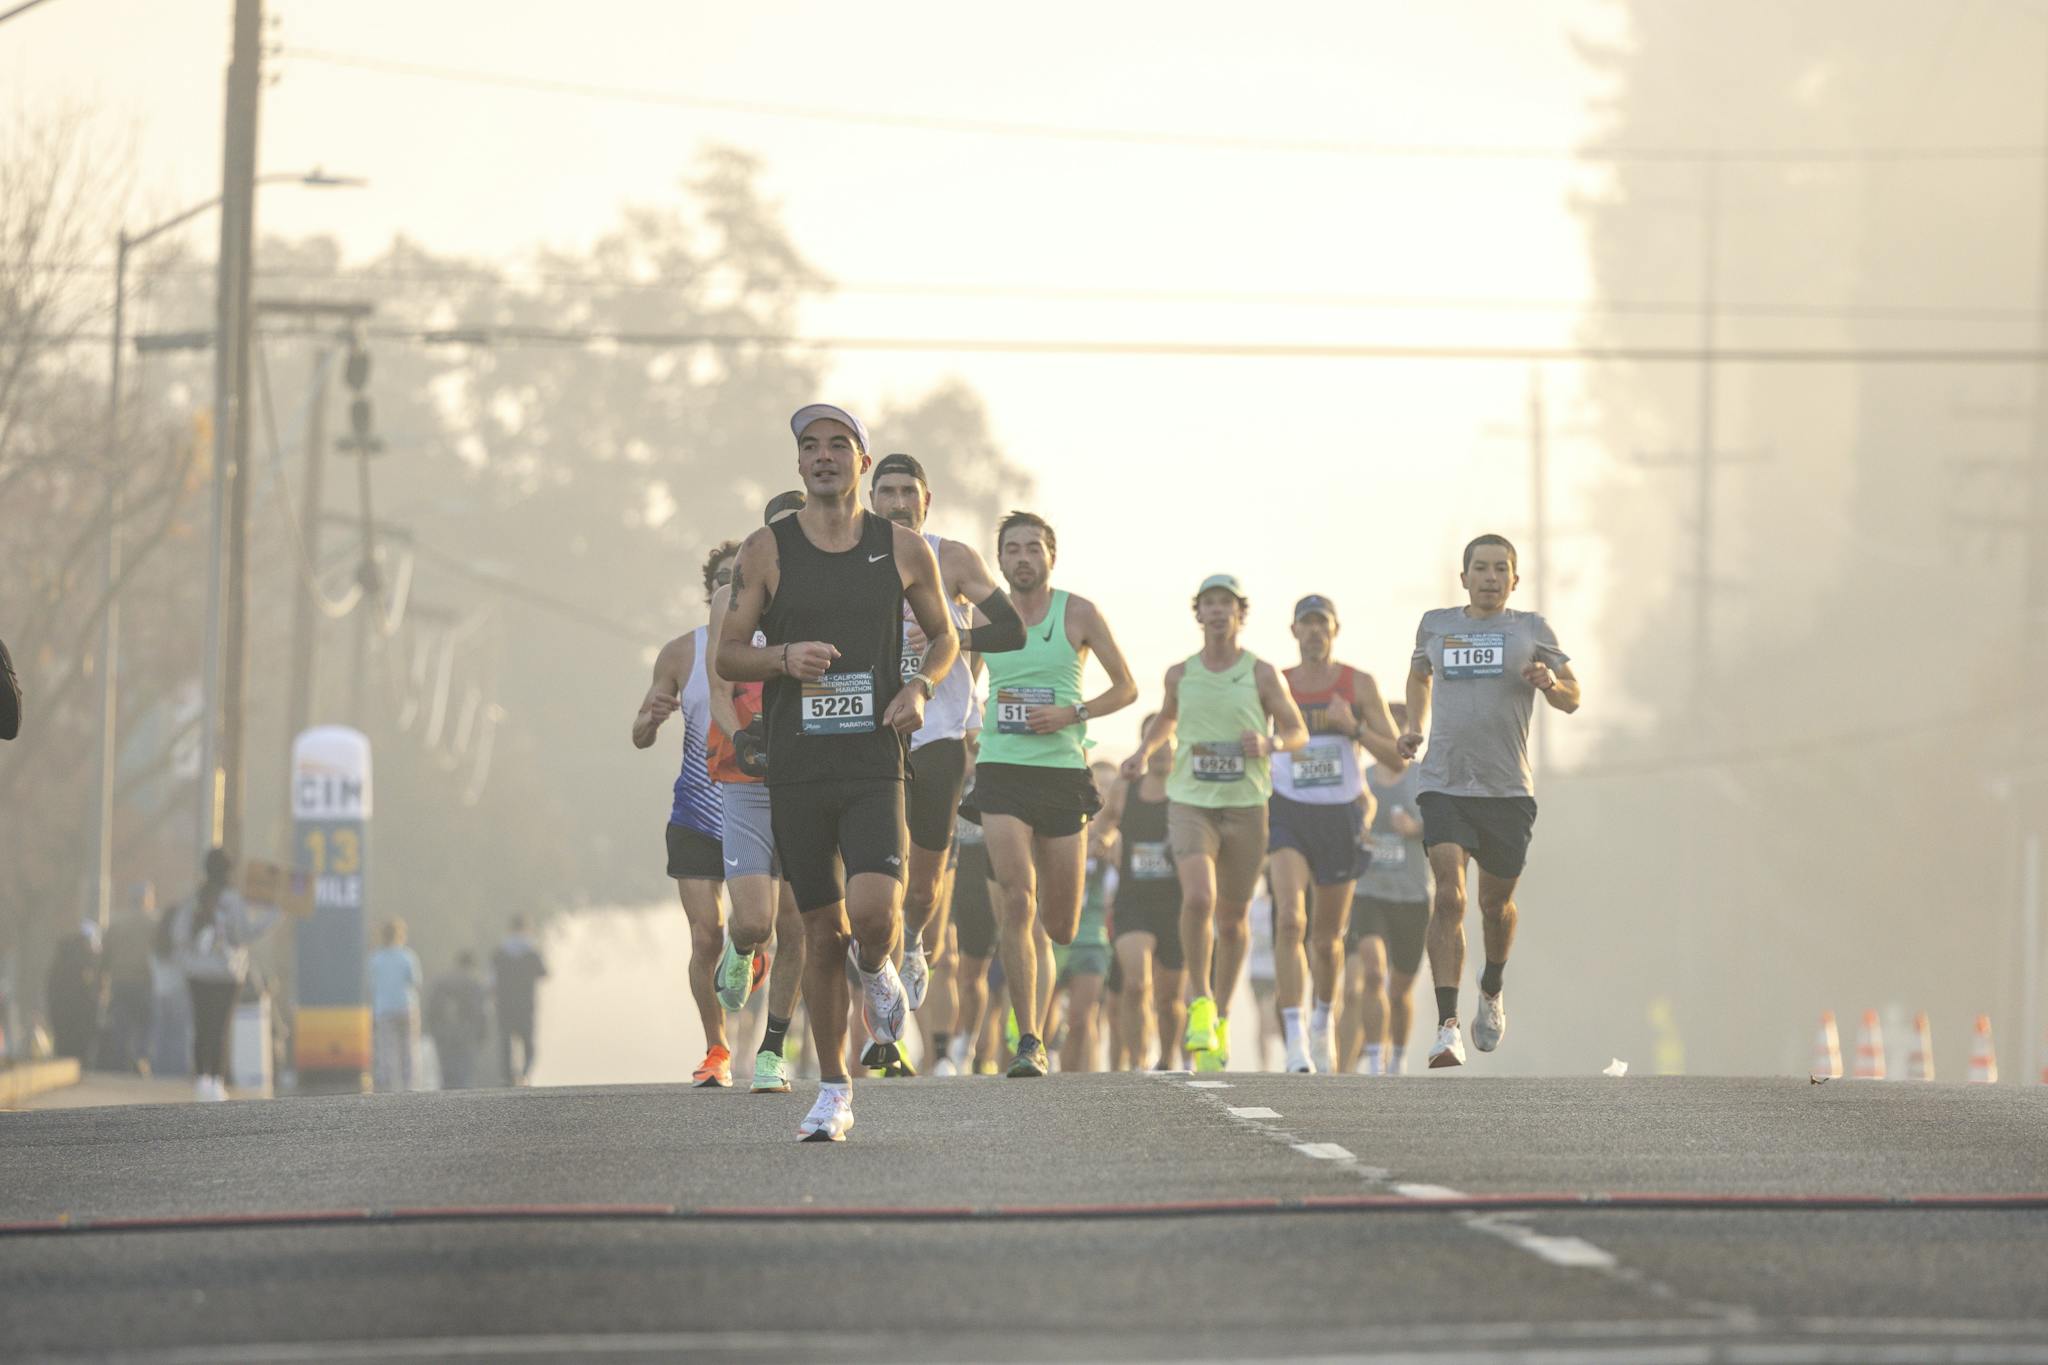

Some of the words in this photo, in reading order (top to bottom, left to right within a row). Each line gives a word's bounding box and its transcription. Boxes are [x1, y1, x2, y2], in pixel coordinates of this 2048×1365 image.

[1452, 649, 1494, 664] 1169
[822, 680, 871, 688] INTERNATIONAL
[812, 696, 863, 717] 5226
[304, 829, 359, 874] 13
